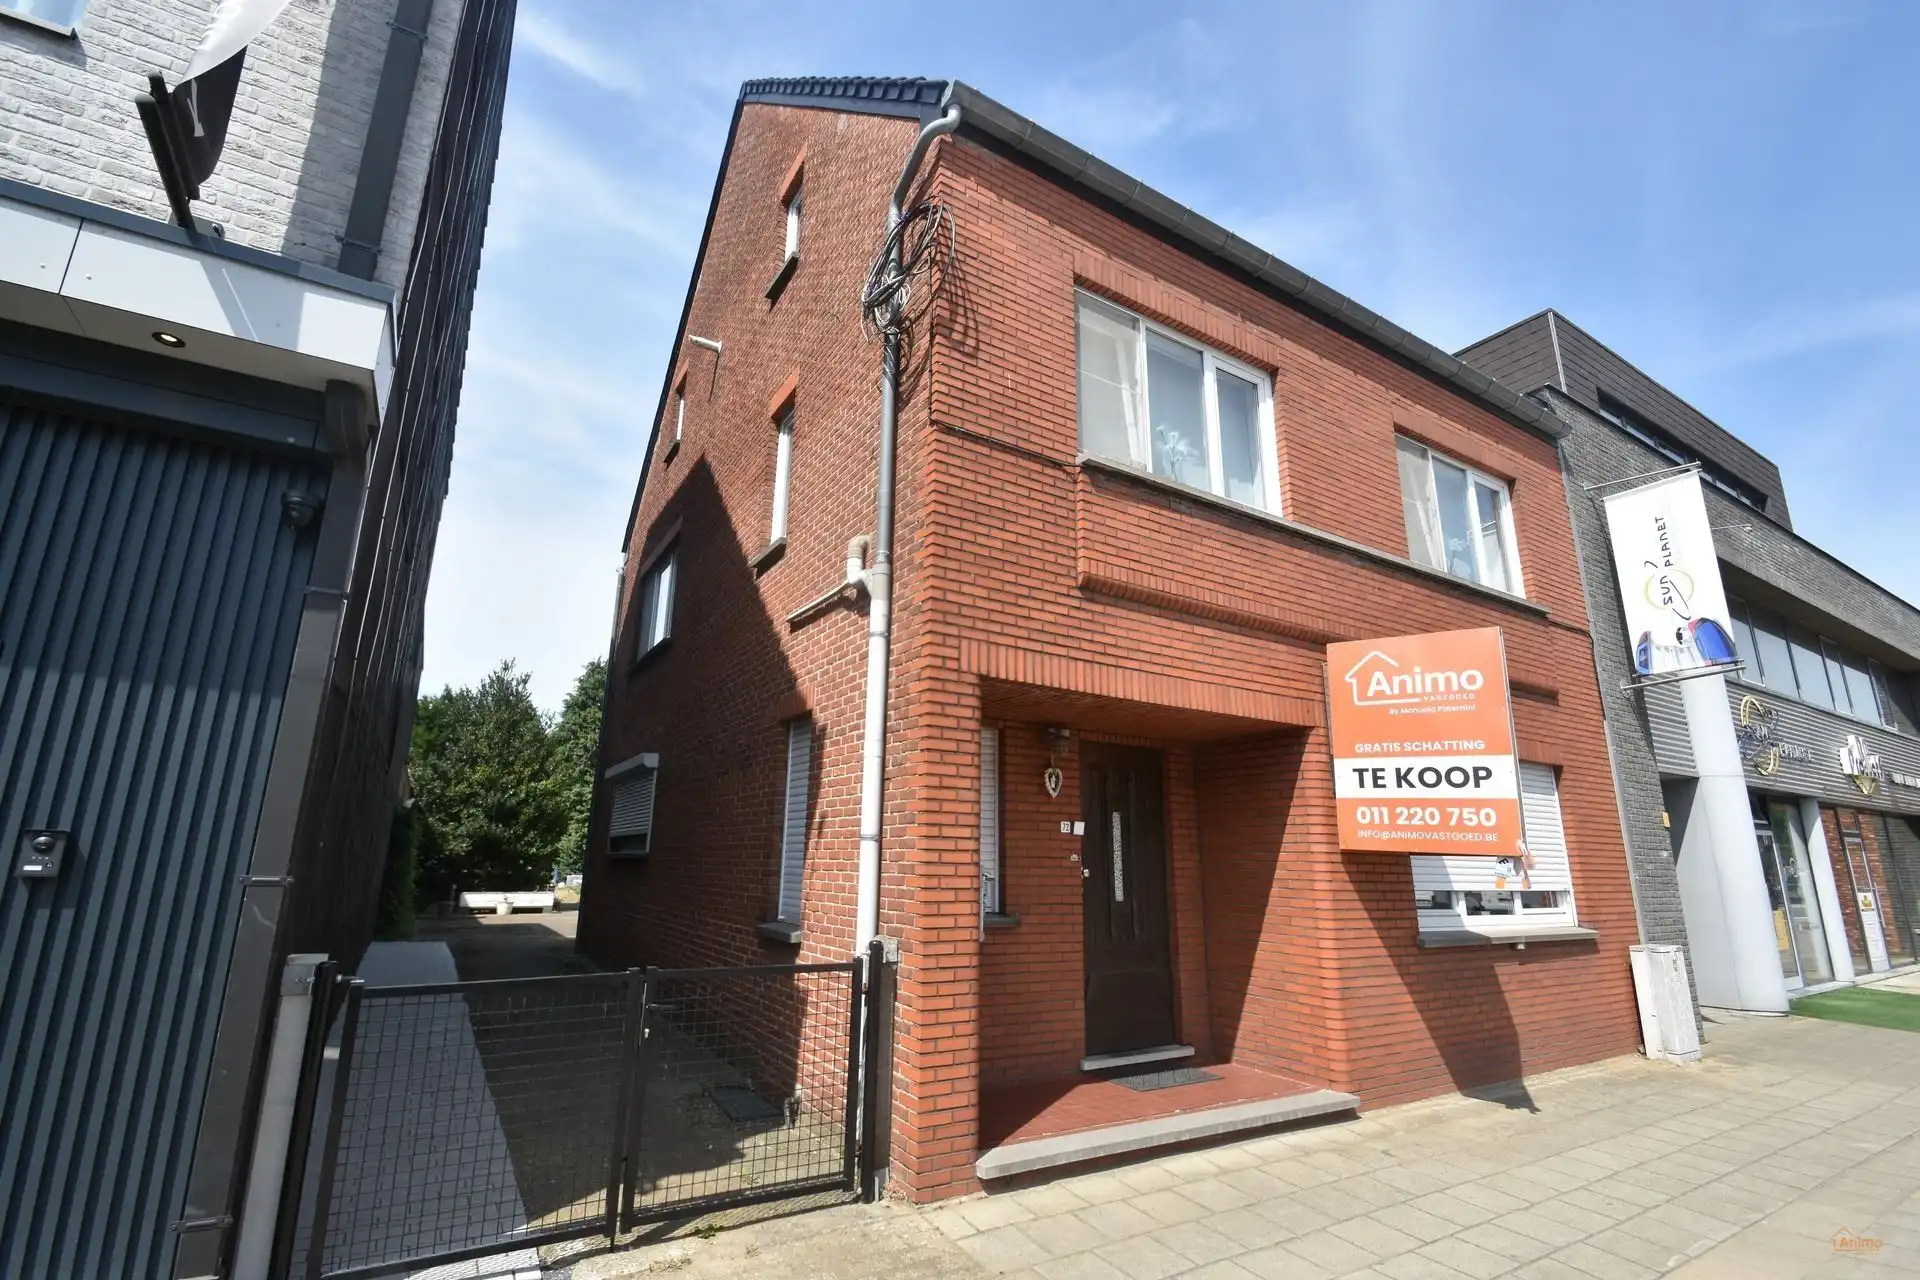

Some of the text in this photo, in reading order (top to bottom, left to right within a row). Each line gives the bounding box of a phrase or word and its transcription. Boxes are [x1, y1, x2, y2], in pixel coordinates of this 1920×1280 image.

[1367, 666, 1484, 696] Animo
[1355, 739, 1486, 753] GRATIS SCHATTING
[1352, 766, 1493, 789] TE KOOP
[1356, 806, 1497, 828] 011 220 750
[1357, 829, 1499, 843] INFO@ANIMOVASTGOED.BE
